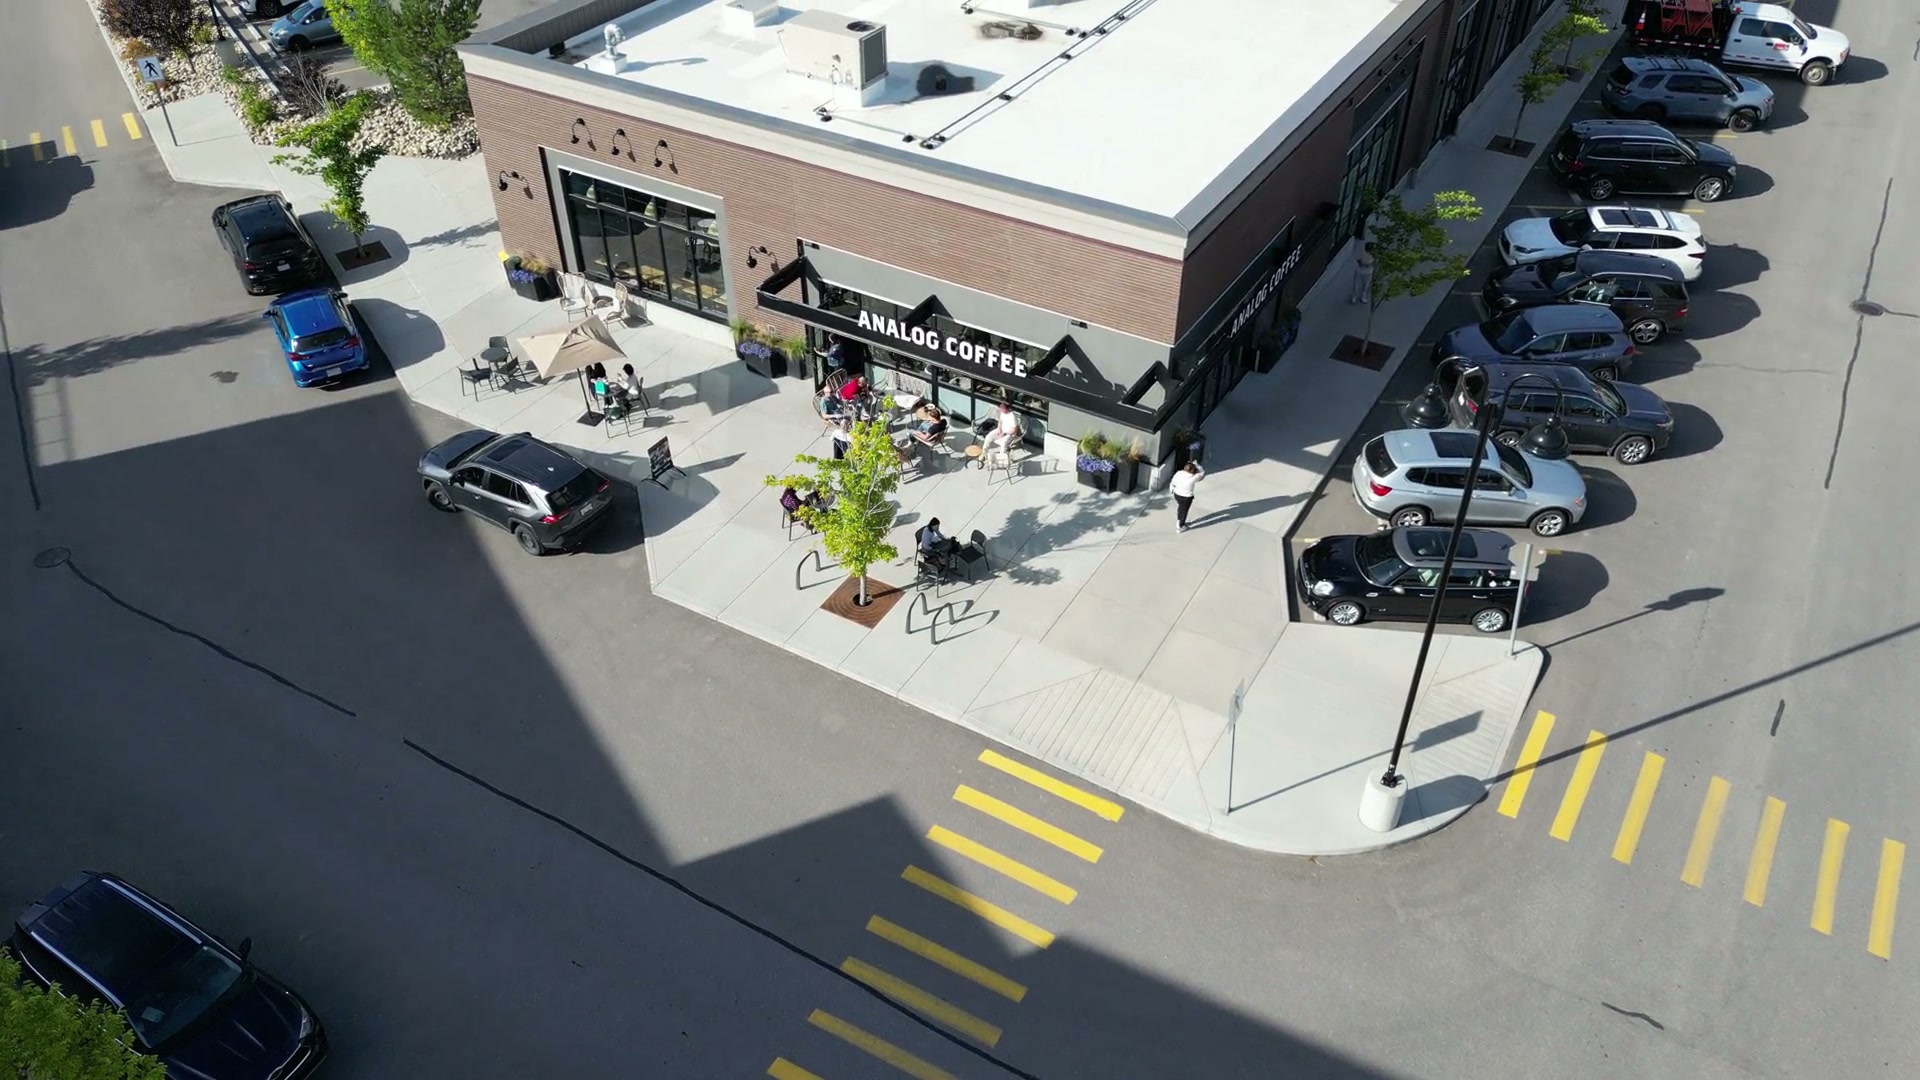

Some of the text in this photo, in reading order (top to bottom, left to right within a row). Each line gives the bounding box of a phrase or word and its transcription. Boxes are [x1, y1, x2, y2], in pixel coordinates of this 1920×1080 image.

[1230, 244, 1302, 338] ANALOG COFFEE
[857, 310, 1028, 378] ANALOG COFFEE
